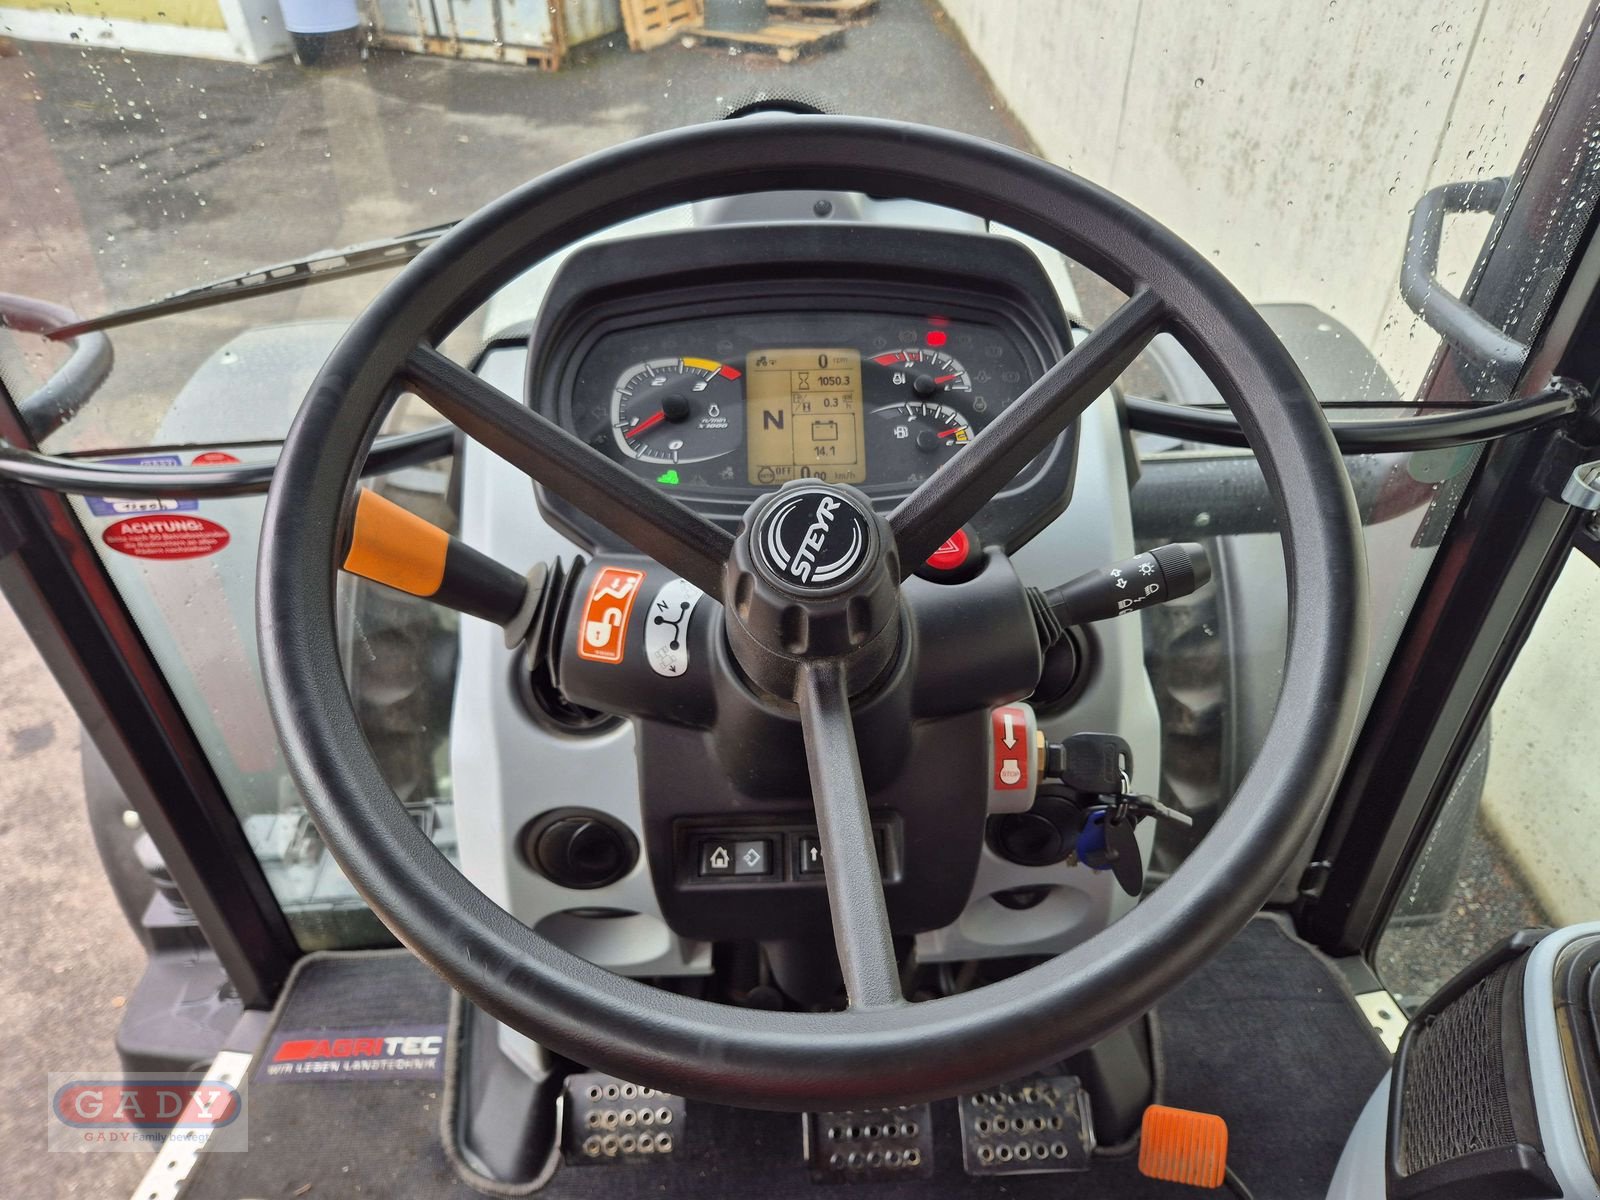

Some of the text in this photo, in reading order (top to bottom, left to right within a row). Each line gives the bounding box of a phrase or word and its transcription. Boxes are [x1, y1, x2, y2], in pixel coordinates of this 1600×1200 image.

[651, 377, 667, 386] 2
[818, 376, 850, 386] 1050.3
[692, 382, 708, 392] 3
[823, 398, 838, 407] 0.3
[630, 417, 640, 426] 1
[763, 410, 784, 430] N
[669, 440, 684, 450] 0
[814, 446, 835, 456] 14.1
[775, 467, 792, 475] OFF
[121, 520, 204, 534] ACHTUNG!
[790, 496, 841, 584] STEYR
[656, 599, 669, 612] N
[309, 1035, 443, 1059] AGRITEC
